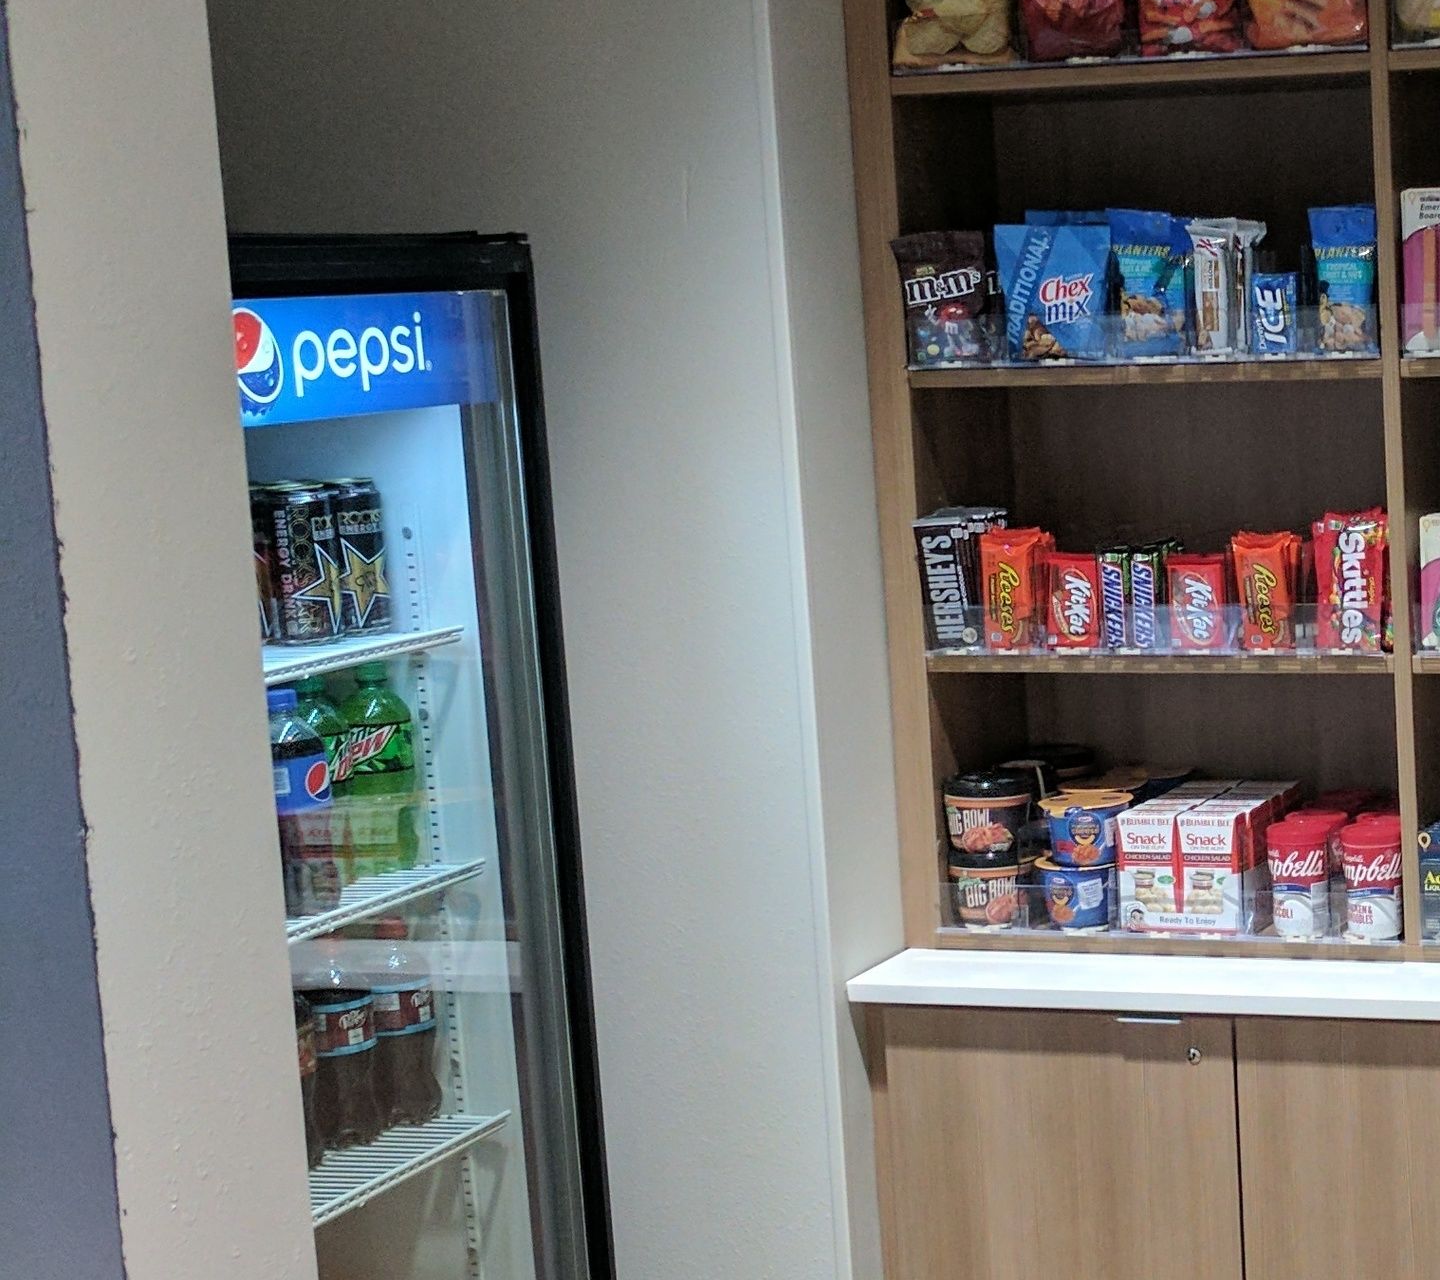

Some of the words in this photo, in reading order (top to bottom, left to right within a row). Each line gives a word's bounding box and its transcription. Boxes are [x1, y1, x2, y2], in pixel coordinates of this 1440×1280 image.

[1005, 235, 1046, 346] TRADITIONAL
[1041, 275, 1093, 303] Chex
[1255, 285, 1289, 344] ICE
[292, 311, 426, 398] pepsi
[1252, 563, 1278, 635] Reese's
[1338, 531, 1369, 645] Skittles
[1126, 832, 1167, 845] Snack
[1186, 833, 1226, 846] Snack
[964, 883, 987, 908] BIG
